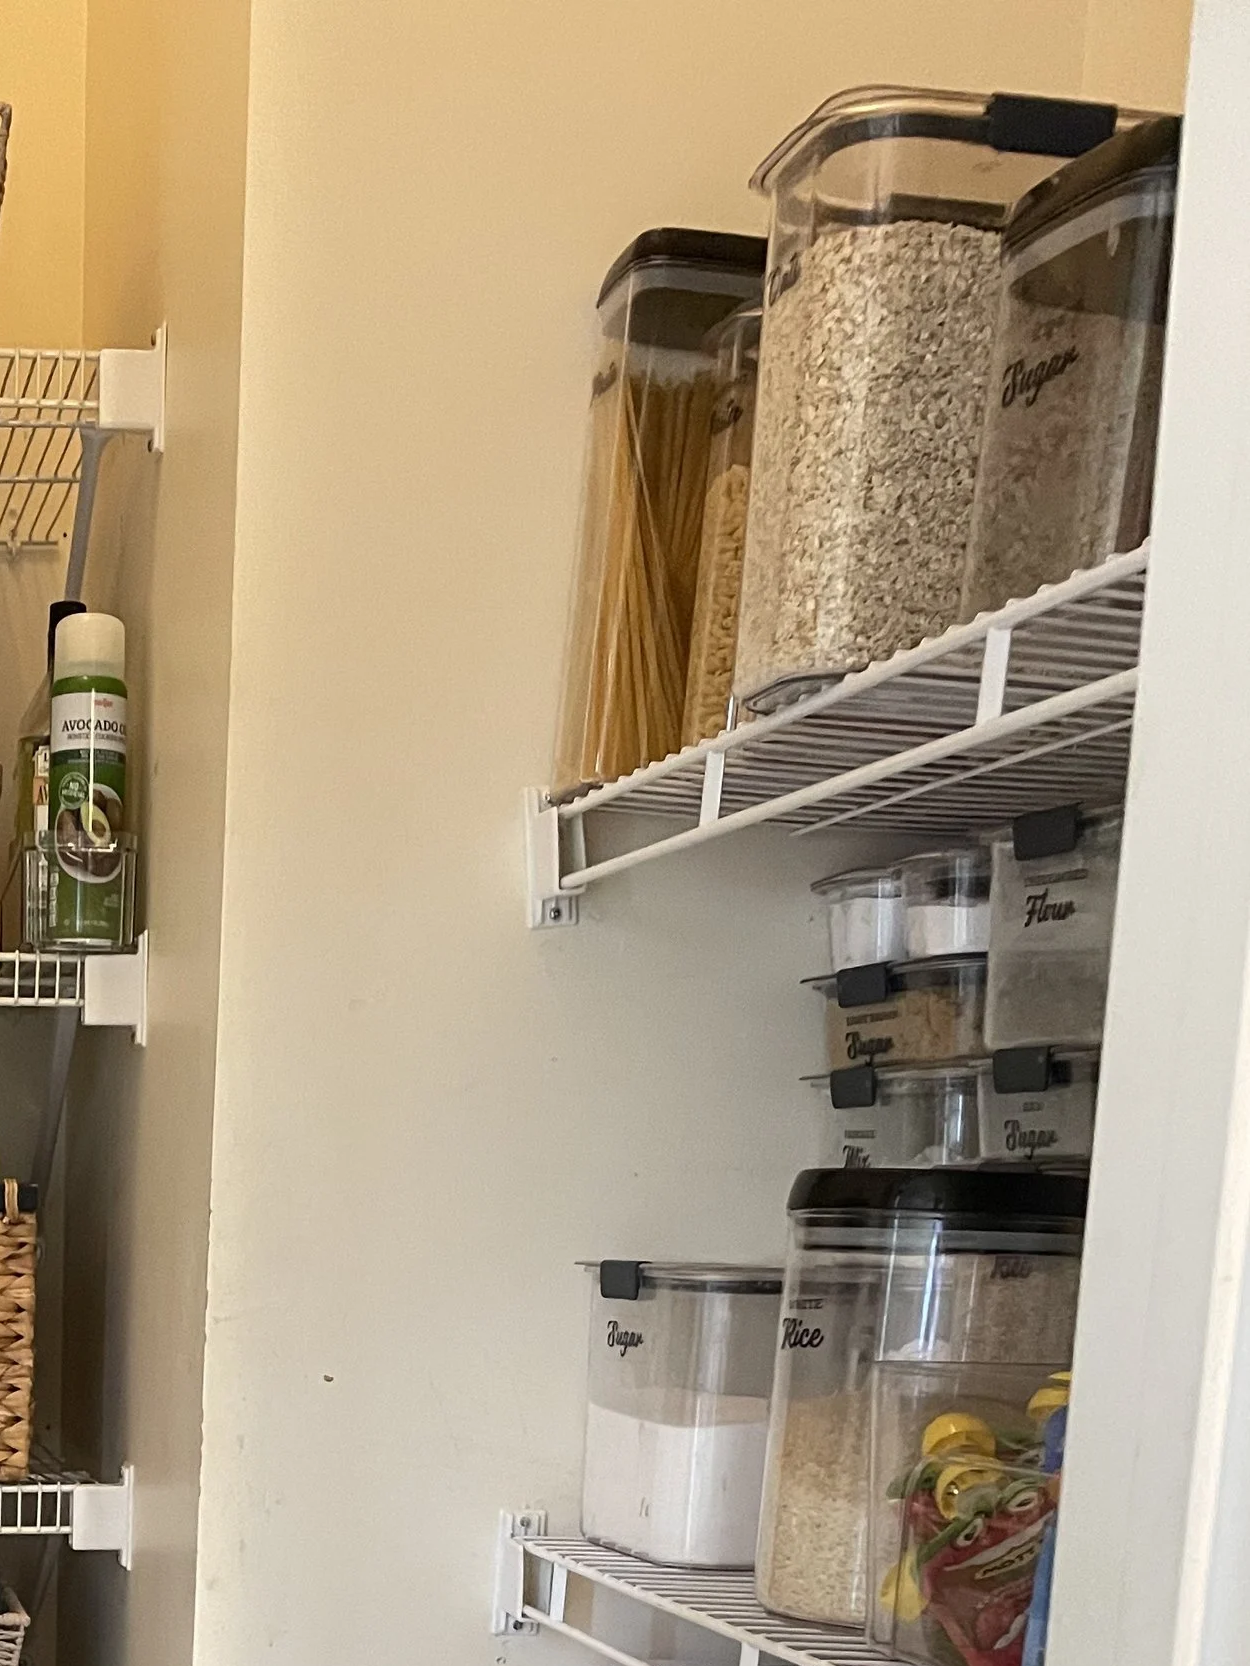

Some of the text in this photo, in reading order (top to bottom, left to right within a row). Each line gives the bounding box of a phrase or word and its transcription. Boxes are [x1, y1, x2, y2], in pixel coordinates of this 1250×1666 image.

[1002, 344, 1080, 409] Sugar
[61, 719, 119, 733] AVOCADO
[1023, 888, 1076, 928] Flour
[845, 1031, 896, 1066] Sugar
[1004, 1119, 1059, 1160] Sugar
[606, 1320, 645, 1357] Sugar
[781, 1317, 825, 1350] Rice
